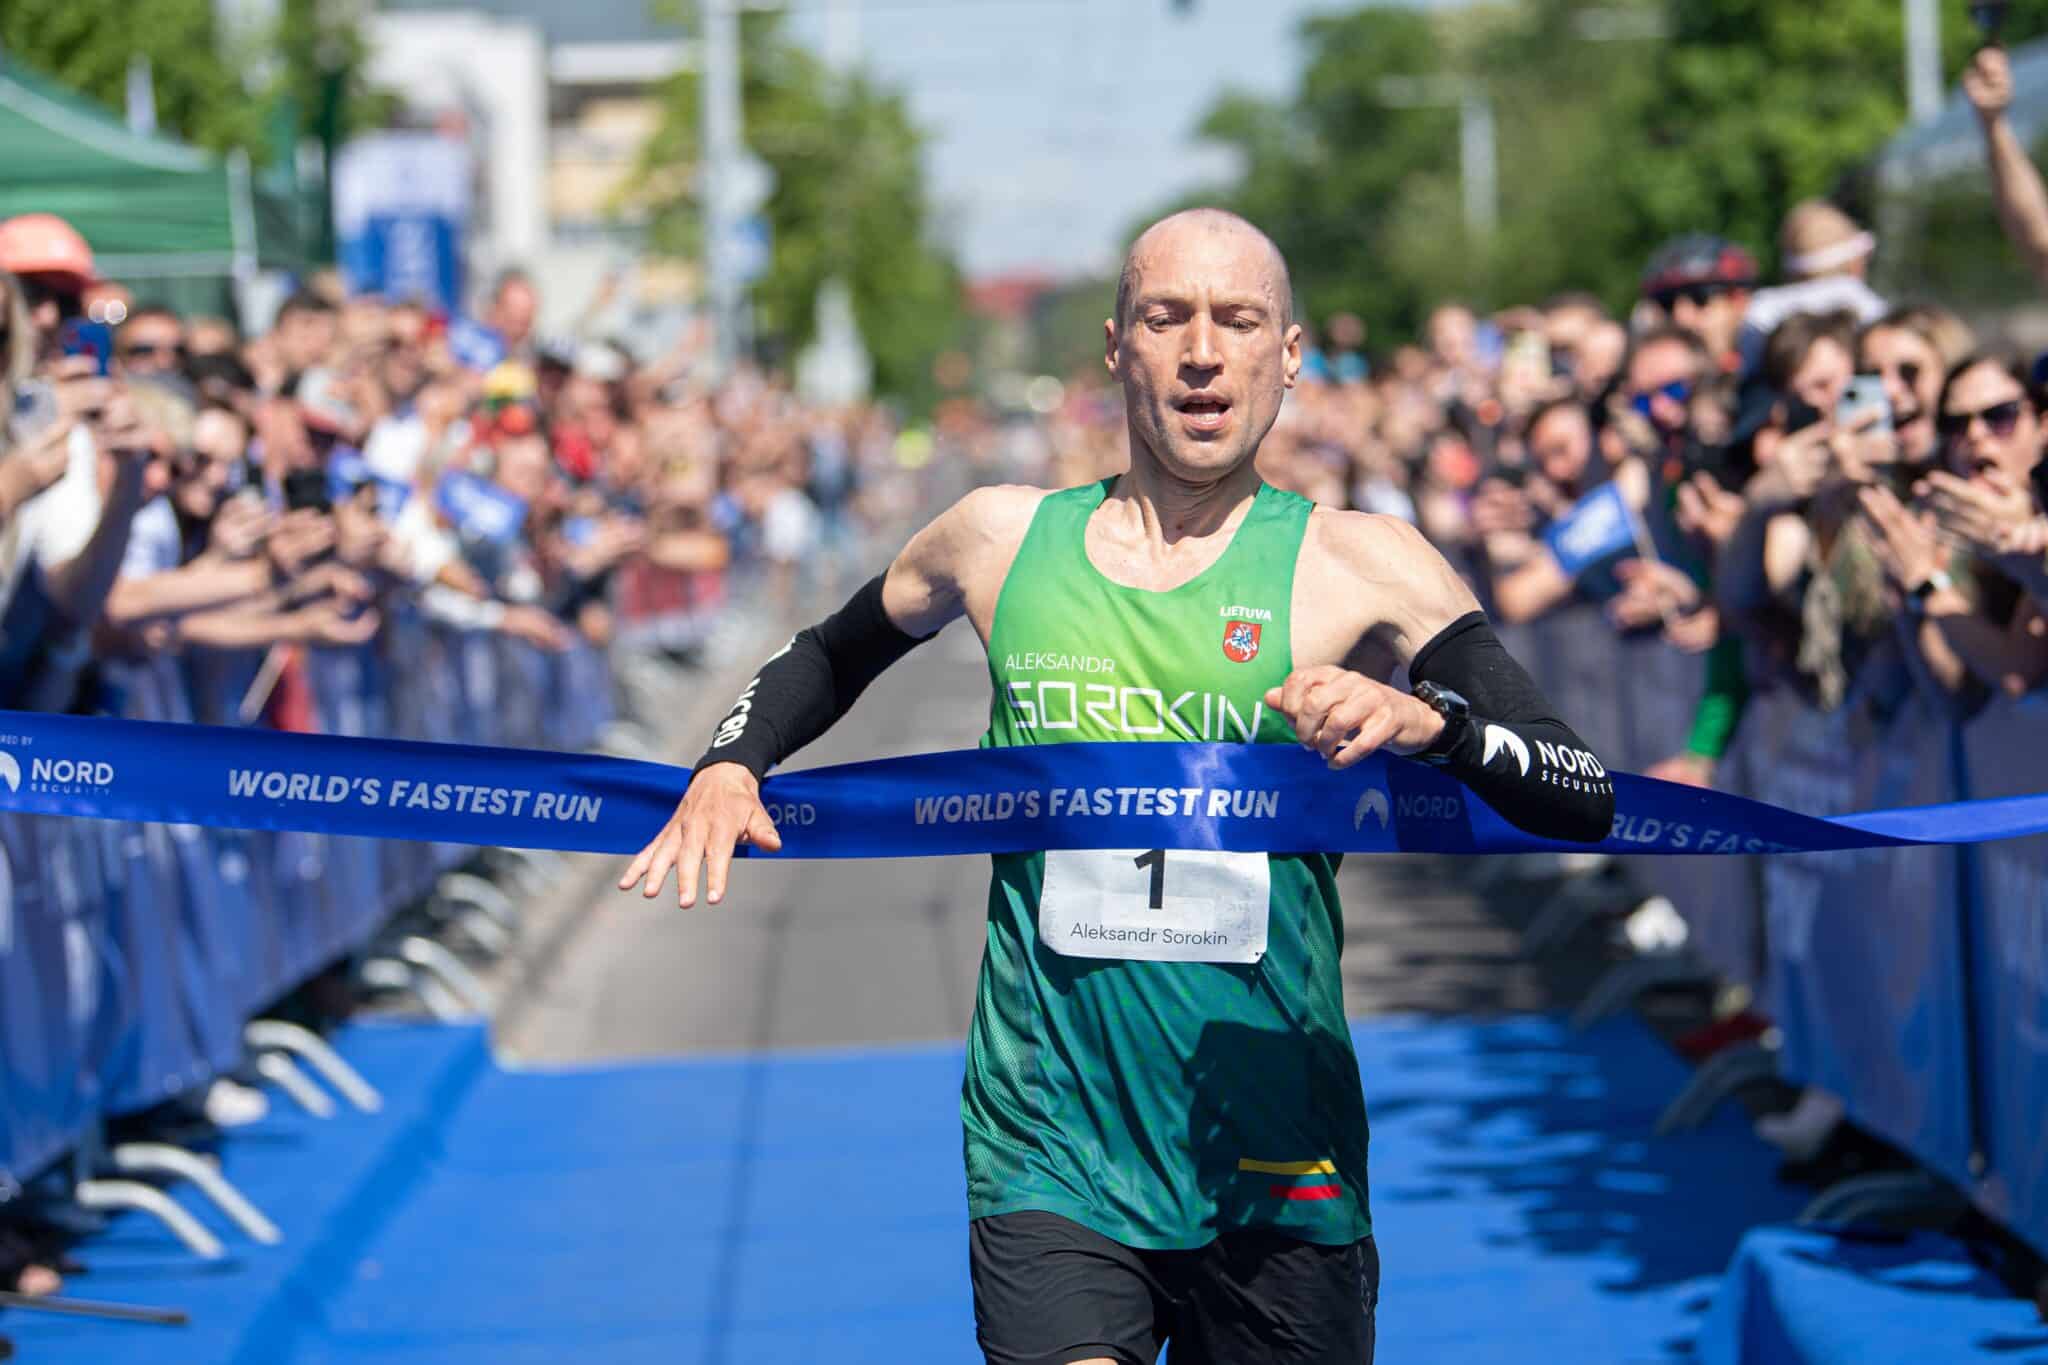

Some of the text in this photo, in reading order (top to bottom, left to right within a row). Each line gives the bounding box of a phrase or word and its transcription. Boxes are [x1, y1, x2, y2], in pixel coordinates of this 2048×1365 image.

[1219, 605, 1273, 621] LIETUVA
[1005, 653, 1116, 673] ALEKSANDR
[1007, 680, 1263, 743] SOROKIN
[31, 758, 114, 785] NORD
[1535, 739, 1606, 778] NORD
[228, 769, 602, 823] WORLD'S FASTEST RUN
[914, 787, 1280, 825] WORLD'S FASTEST RUN
[1397, 794, 1458, 819] NORD
[767, 803, 816, 826] ORD
[1608, 813, 1694, 848] RLD'S
[1134, 849, 1166, 910] 1
[1070, 922, 1228, 947] Aleksandr Sorokin
